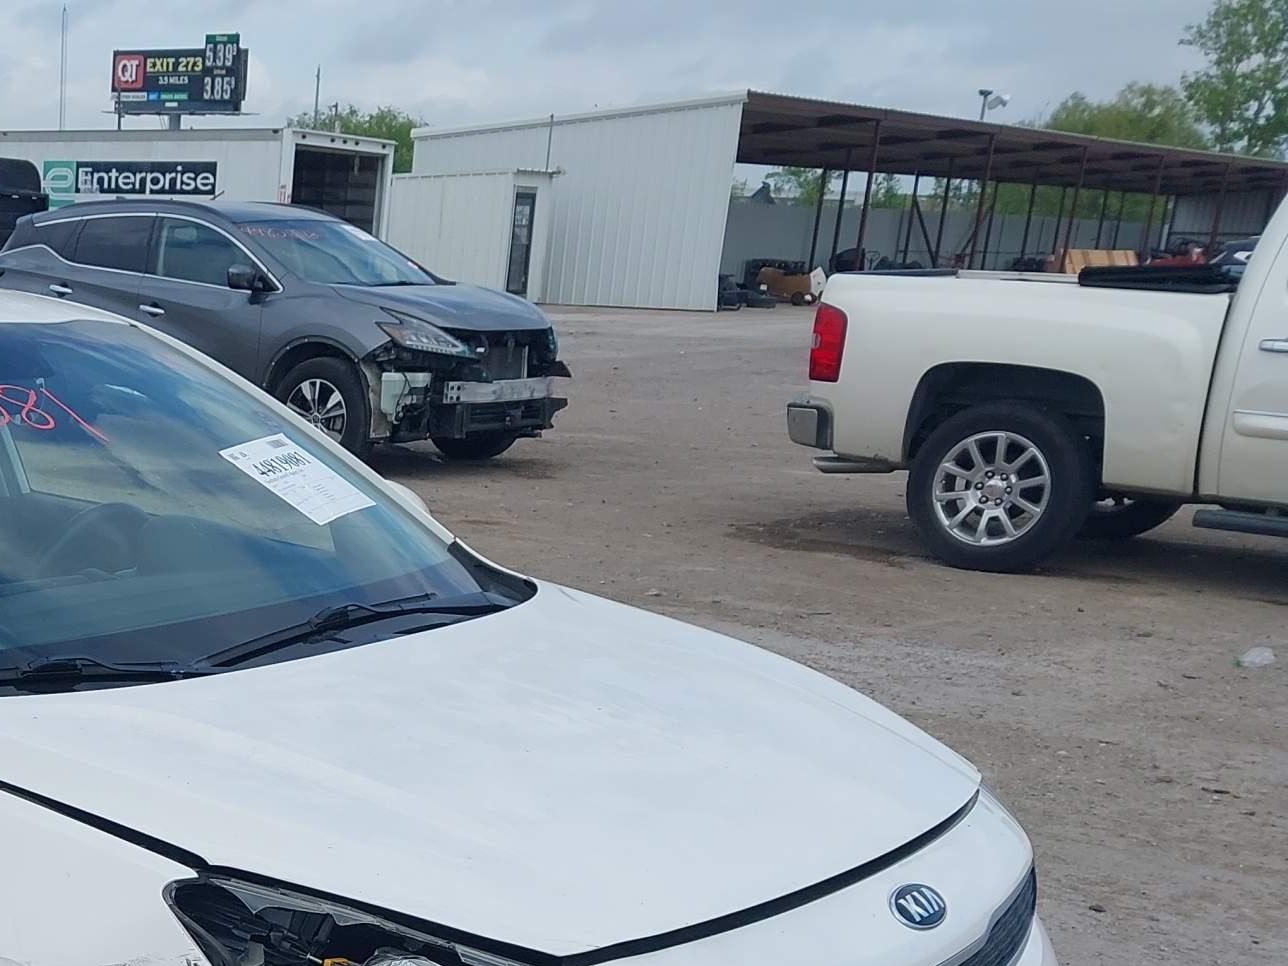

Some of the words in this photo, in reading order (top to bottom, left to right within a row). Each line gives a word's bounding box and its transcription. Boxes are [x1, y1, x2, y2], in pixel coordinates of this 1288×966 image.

[118, 60, 139, 82] QT
[146, 58, 175, 72] EXIT
[178, 57, 203, 71] 273
[169, 76, 189, 84] MILES
[78, 165, 215, 195] Enterprise
[252, 451, 312, 477] 44819081
[898, 887, 945, 922] KIA
